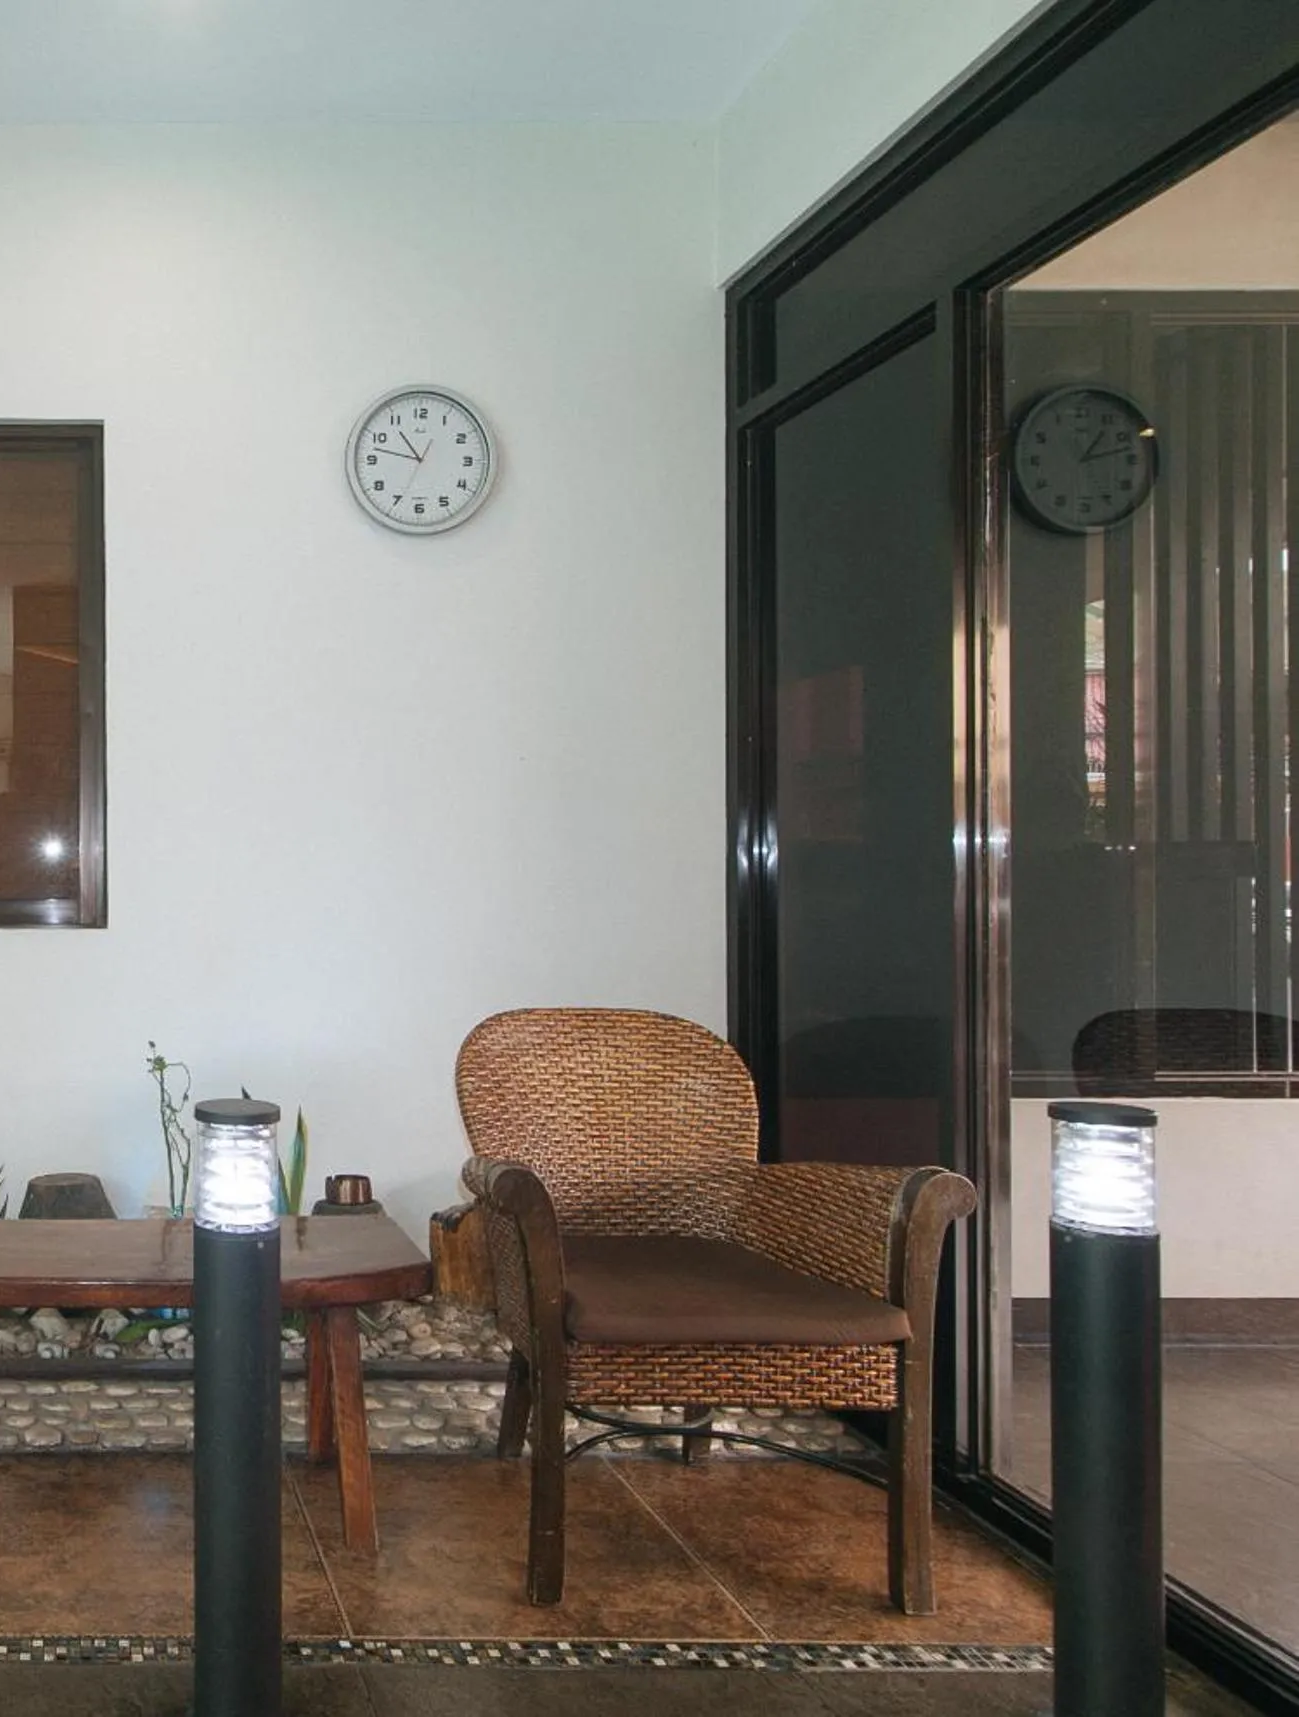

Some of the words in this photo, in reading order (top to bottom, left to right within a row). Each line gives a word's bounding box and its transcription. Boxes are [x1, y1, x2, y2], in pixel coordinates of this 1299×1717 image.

[413, 408, 428, 419] 12
[391, 415, 401, 426] 11
[442, 415, 447, 426] 1
[373, 433, 387, 443] 10
[456, 433, 466, 444] 2
[367, 455, 377, 465] 9
[463, 457, 473, 466] 3
[374, 481, 384, 490] 8
[456, 480, 466, 490] 4
[393, 495, 403, 505] 7
[439, 496, 449, 507] 5
[415, 504, 424, 513] 6
